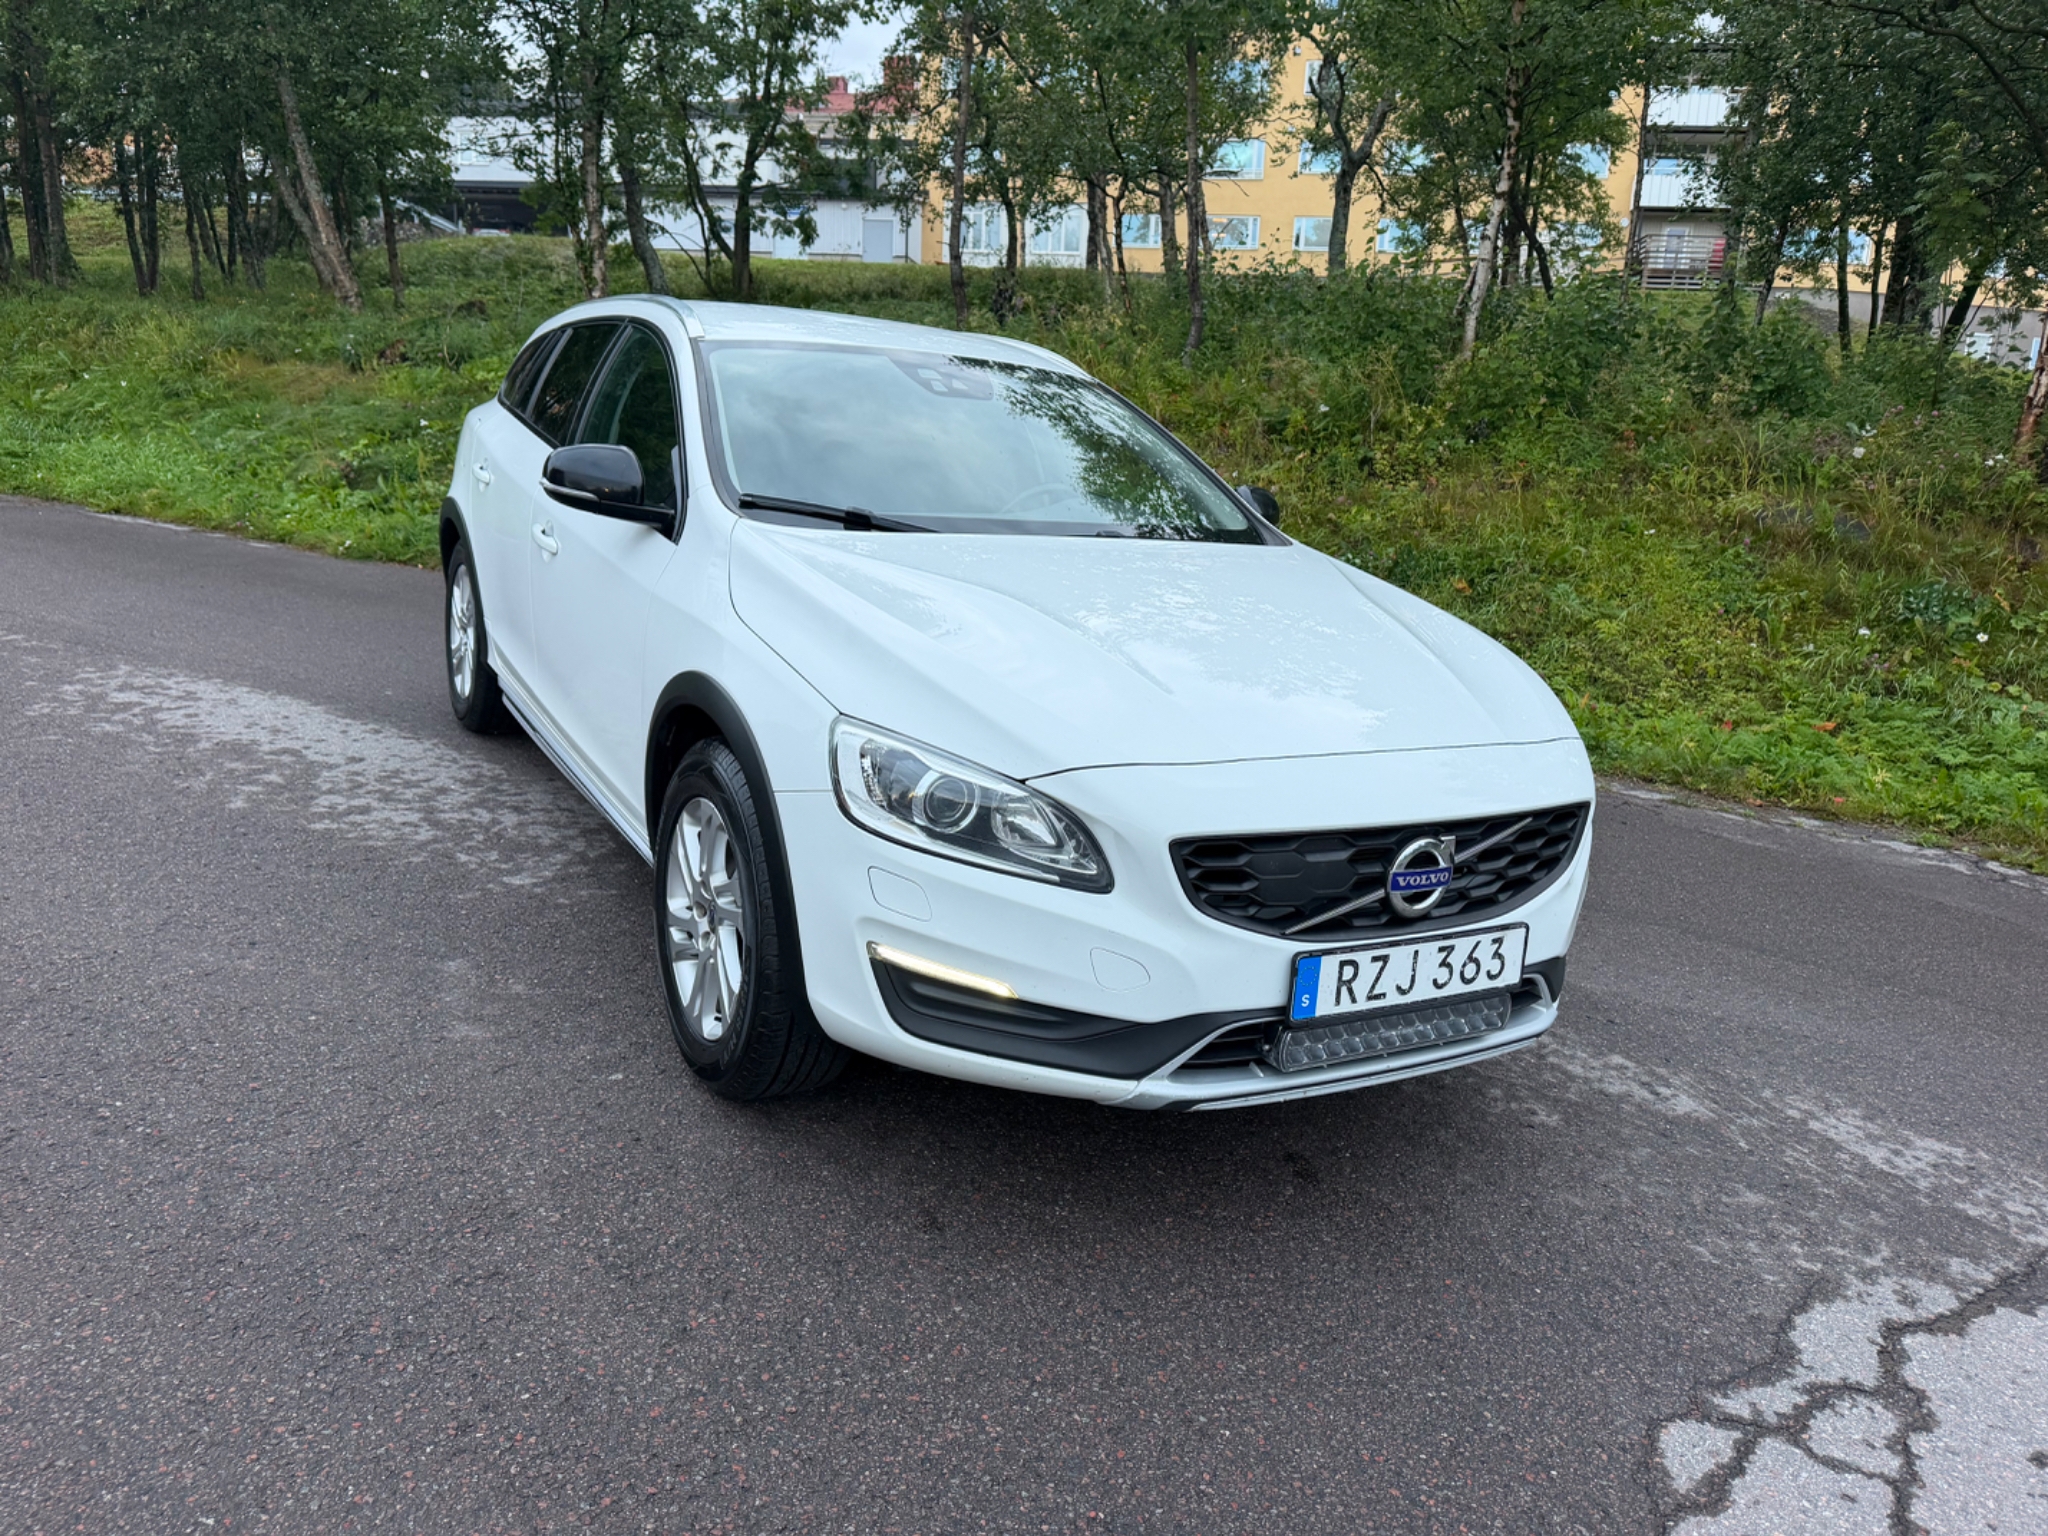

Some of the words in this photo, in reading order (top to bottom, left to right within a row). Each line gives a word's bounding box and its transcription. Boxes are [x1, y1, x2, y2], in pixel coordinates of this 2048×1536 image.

[1396, 871, 1449, 887] VOLVO
[1334, 950, 1419, 1007] RZJ
[1432, 937, 1506, 990] 363
[1301, 995, 1310, 1008] S
